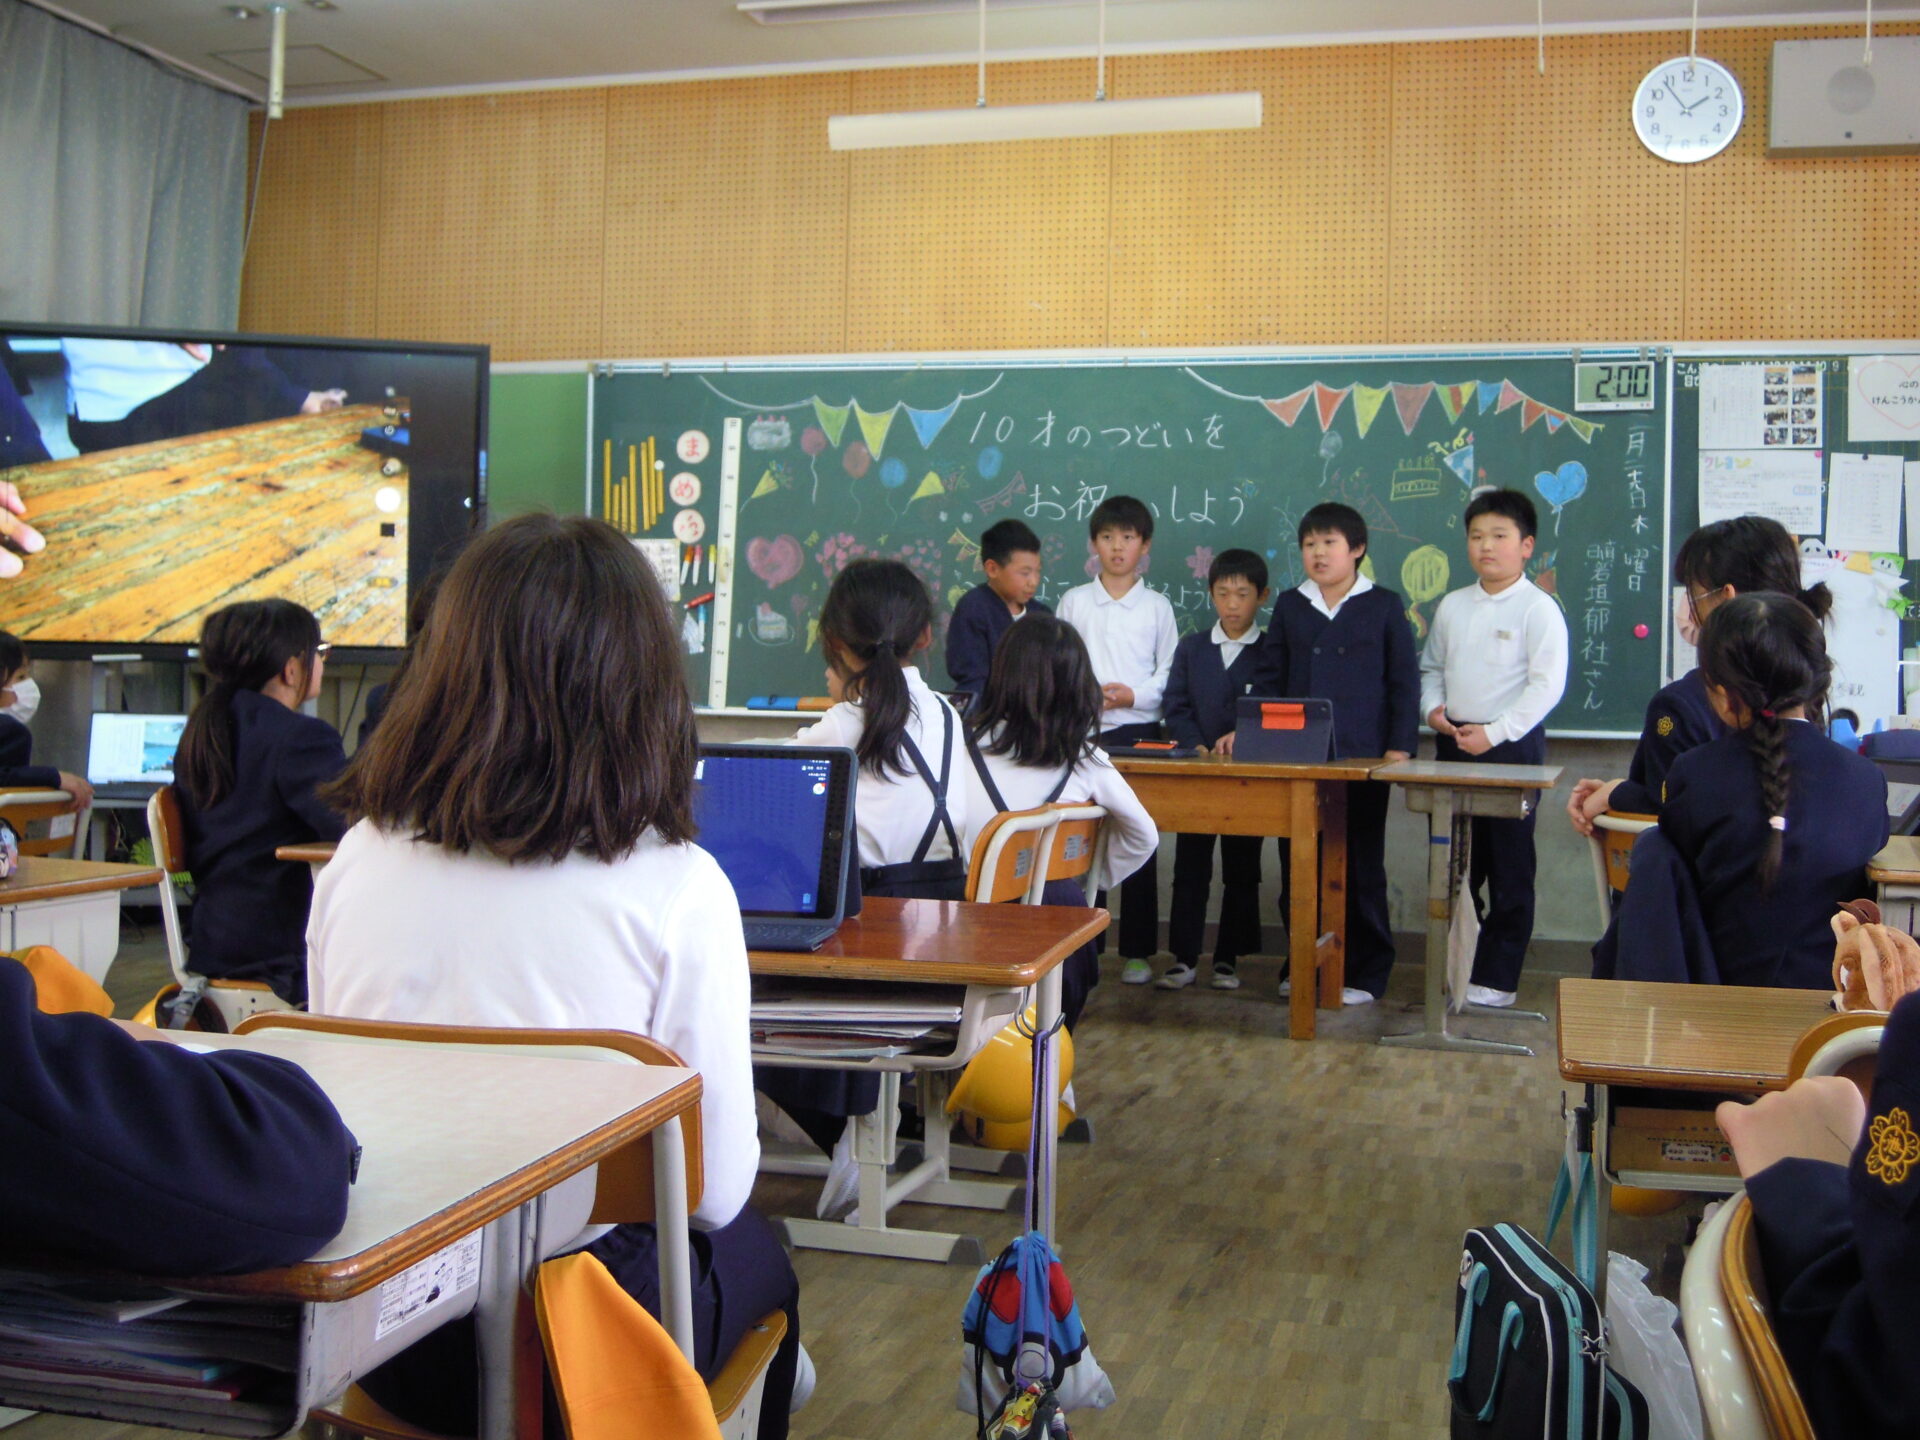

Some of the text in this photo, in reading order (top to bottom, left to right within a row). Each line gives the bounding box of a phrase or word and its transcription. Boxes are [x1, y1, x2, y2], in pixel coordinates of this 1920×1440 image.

[1682, 69, 1695, 83] 12
[1652, 88, 1664, 101] 10
[1714, 87, 1723, 99] 2
[1646, 106, 1655, 118] 9
[1719, 105, 1728, 117] 3
[1651, 123, 1660, 135] 8
[1712, 122, 1721, 134] 4
[1596, 365, 1650, 398] 2:00
[1871, 395, 1920, 406] けんこうか
[685, 436, 701, 457] ま
[674, 479, 695, 500] め
